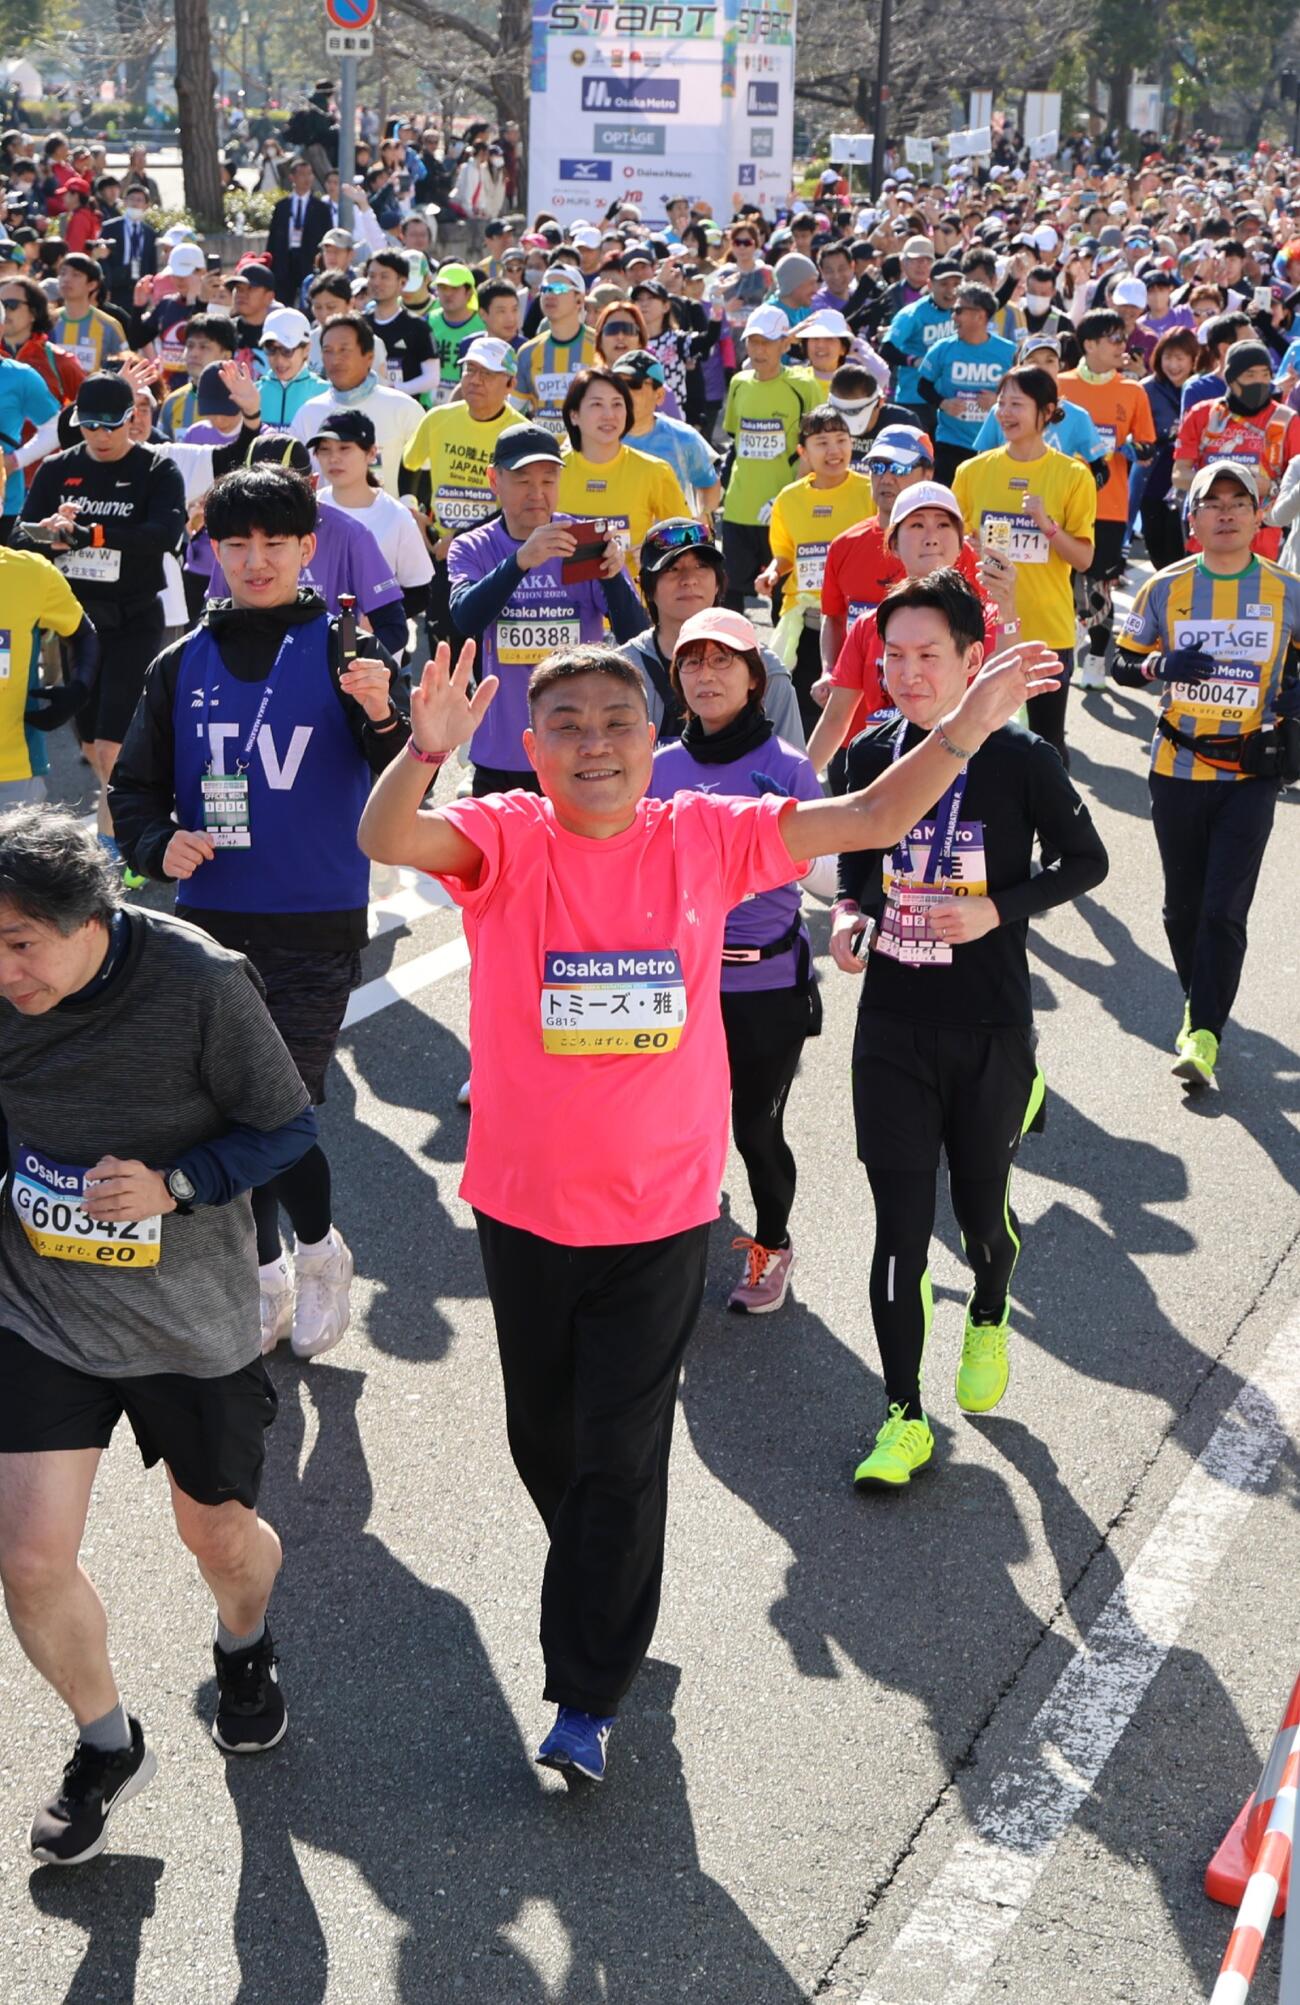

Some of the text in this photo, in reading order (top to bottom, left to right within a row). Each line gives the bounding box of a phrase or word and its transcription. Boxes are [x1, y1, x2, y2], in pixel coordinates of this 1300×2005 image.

[329, 37, 370, 50] 自動車
[614, 97, 676, 109] Osaka Metro
[602, 130, 656, 145] OPTAGE
[951, 361, 1003, 382] DMC
[756, 421, 781, 430] Metro
[1231, 455, 1256, 464] Metro
[450, 459, 487, 476] JAPAN
[438, 487, 492, 500] Osaka Metro
[1012, 533, 1040, 549] 171
[99, 550, 111, 561] W
[798, 545, 826, 556] Osaka
[518, 574, 557, 589] AKA
[502, 606, 574, 618] Osaka Metro
[1178, 630, 1269, 648] OPTAGE
[1218, 665, 1254, 679] Metro
[873, 707, 901, 719] Osak
[1221, 708, 1243, 719] eo
[196, 722, 314, 791] TV
[946, 799, 961, 836] MARATHON
[925, 826, 973, 842] Mro
[552, 958, 676, 977] Osaka Metro
[549, 992, 673, 1015] トミーズ・雅
[546, 1016, 577, 1027] G815
[633, 1031, 669, 1049] eo
[25, 1155, 79, 1190] Osaka
[95, 1245, 136, 1262] eo
